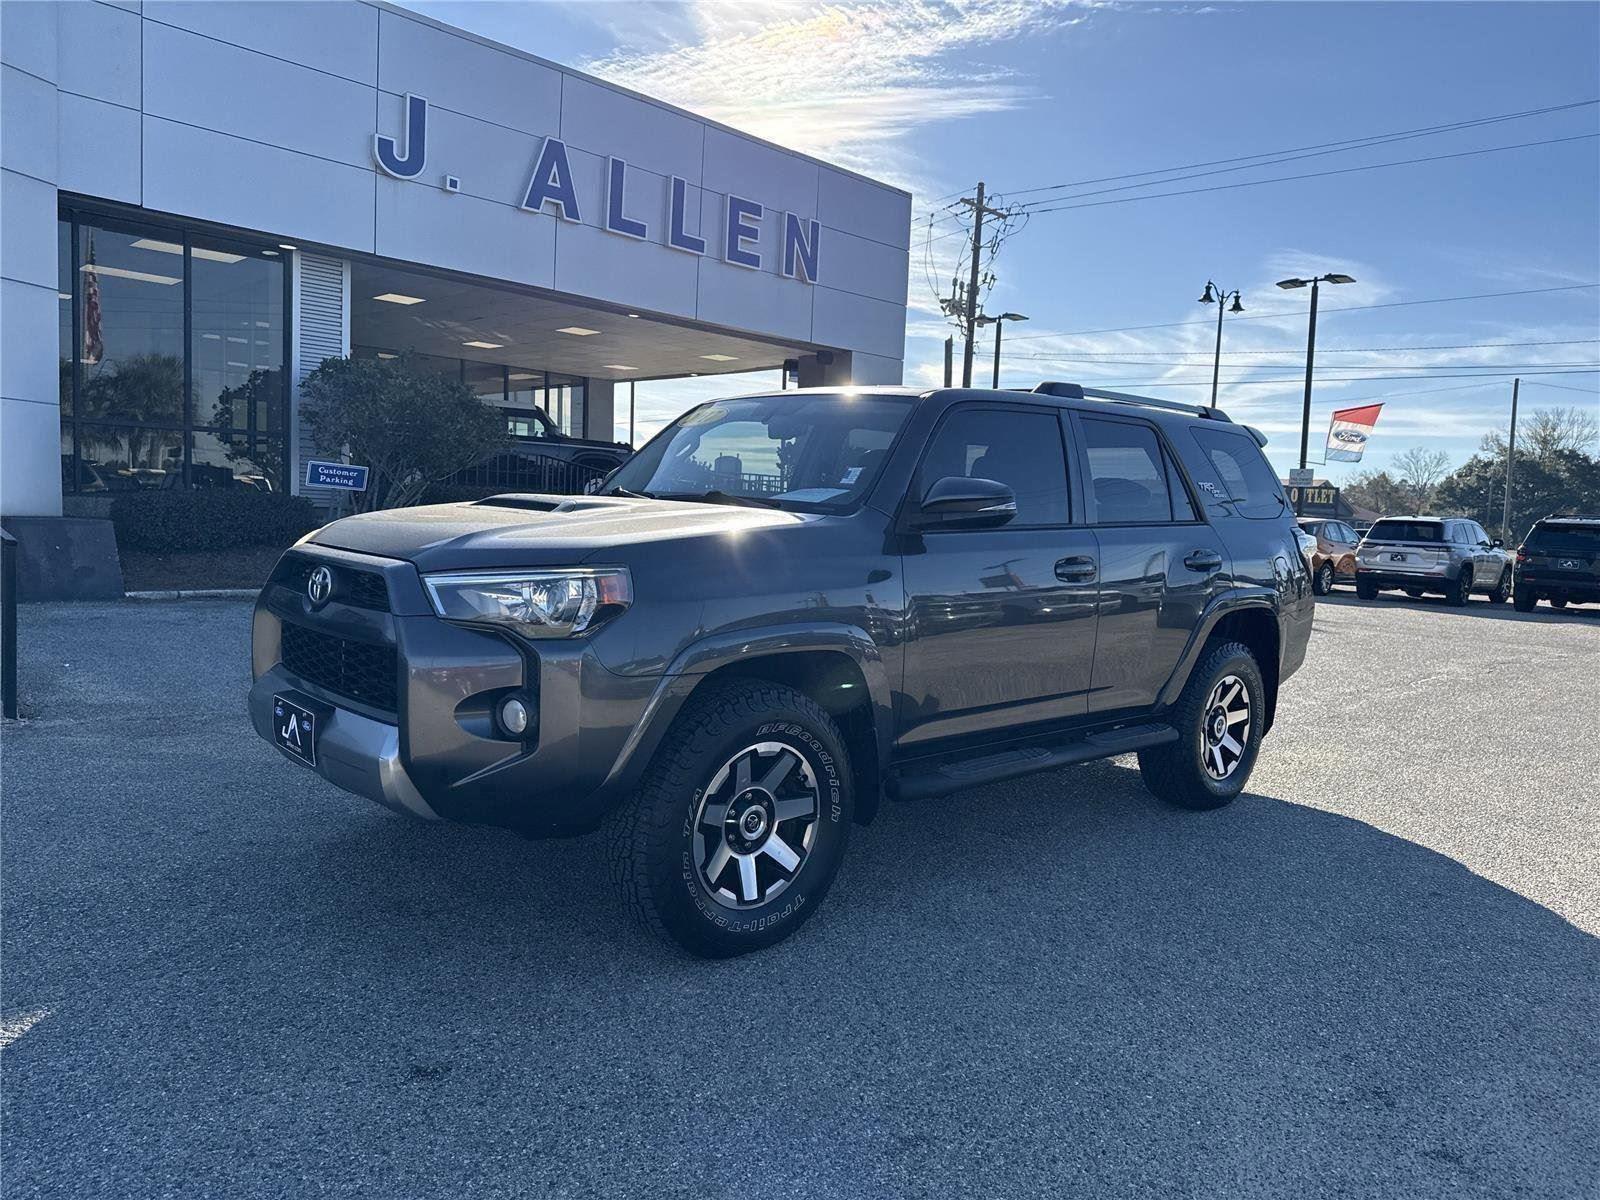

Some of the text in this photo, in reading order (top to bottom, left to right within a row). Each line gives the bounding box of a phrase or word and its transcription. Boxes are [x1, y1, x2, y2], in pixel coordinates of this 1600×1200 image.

[373, 92, 821, 284] J. ALLEN
[1338, 430, 1363, 443] Ford
[318, 466, 358, 477] Customer
[320, 475, 354, 486] Parking
[1290, 487, 1336, 504] OTLET
[756, 722, 842, 822] BFGoodrich
[682, 850, 806, 933] Trail-Terrain
